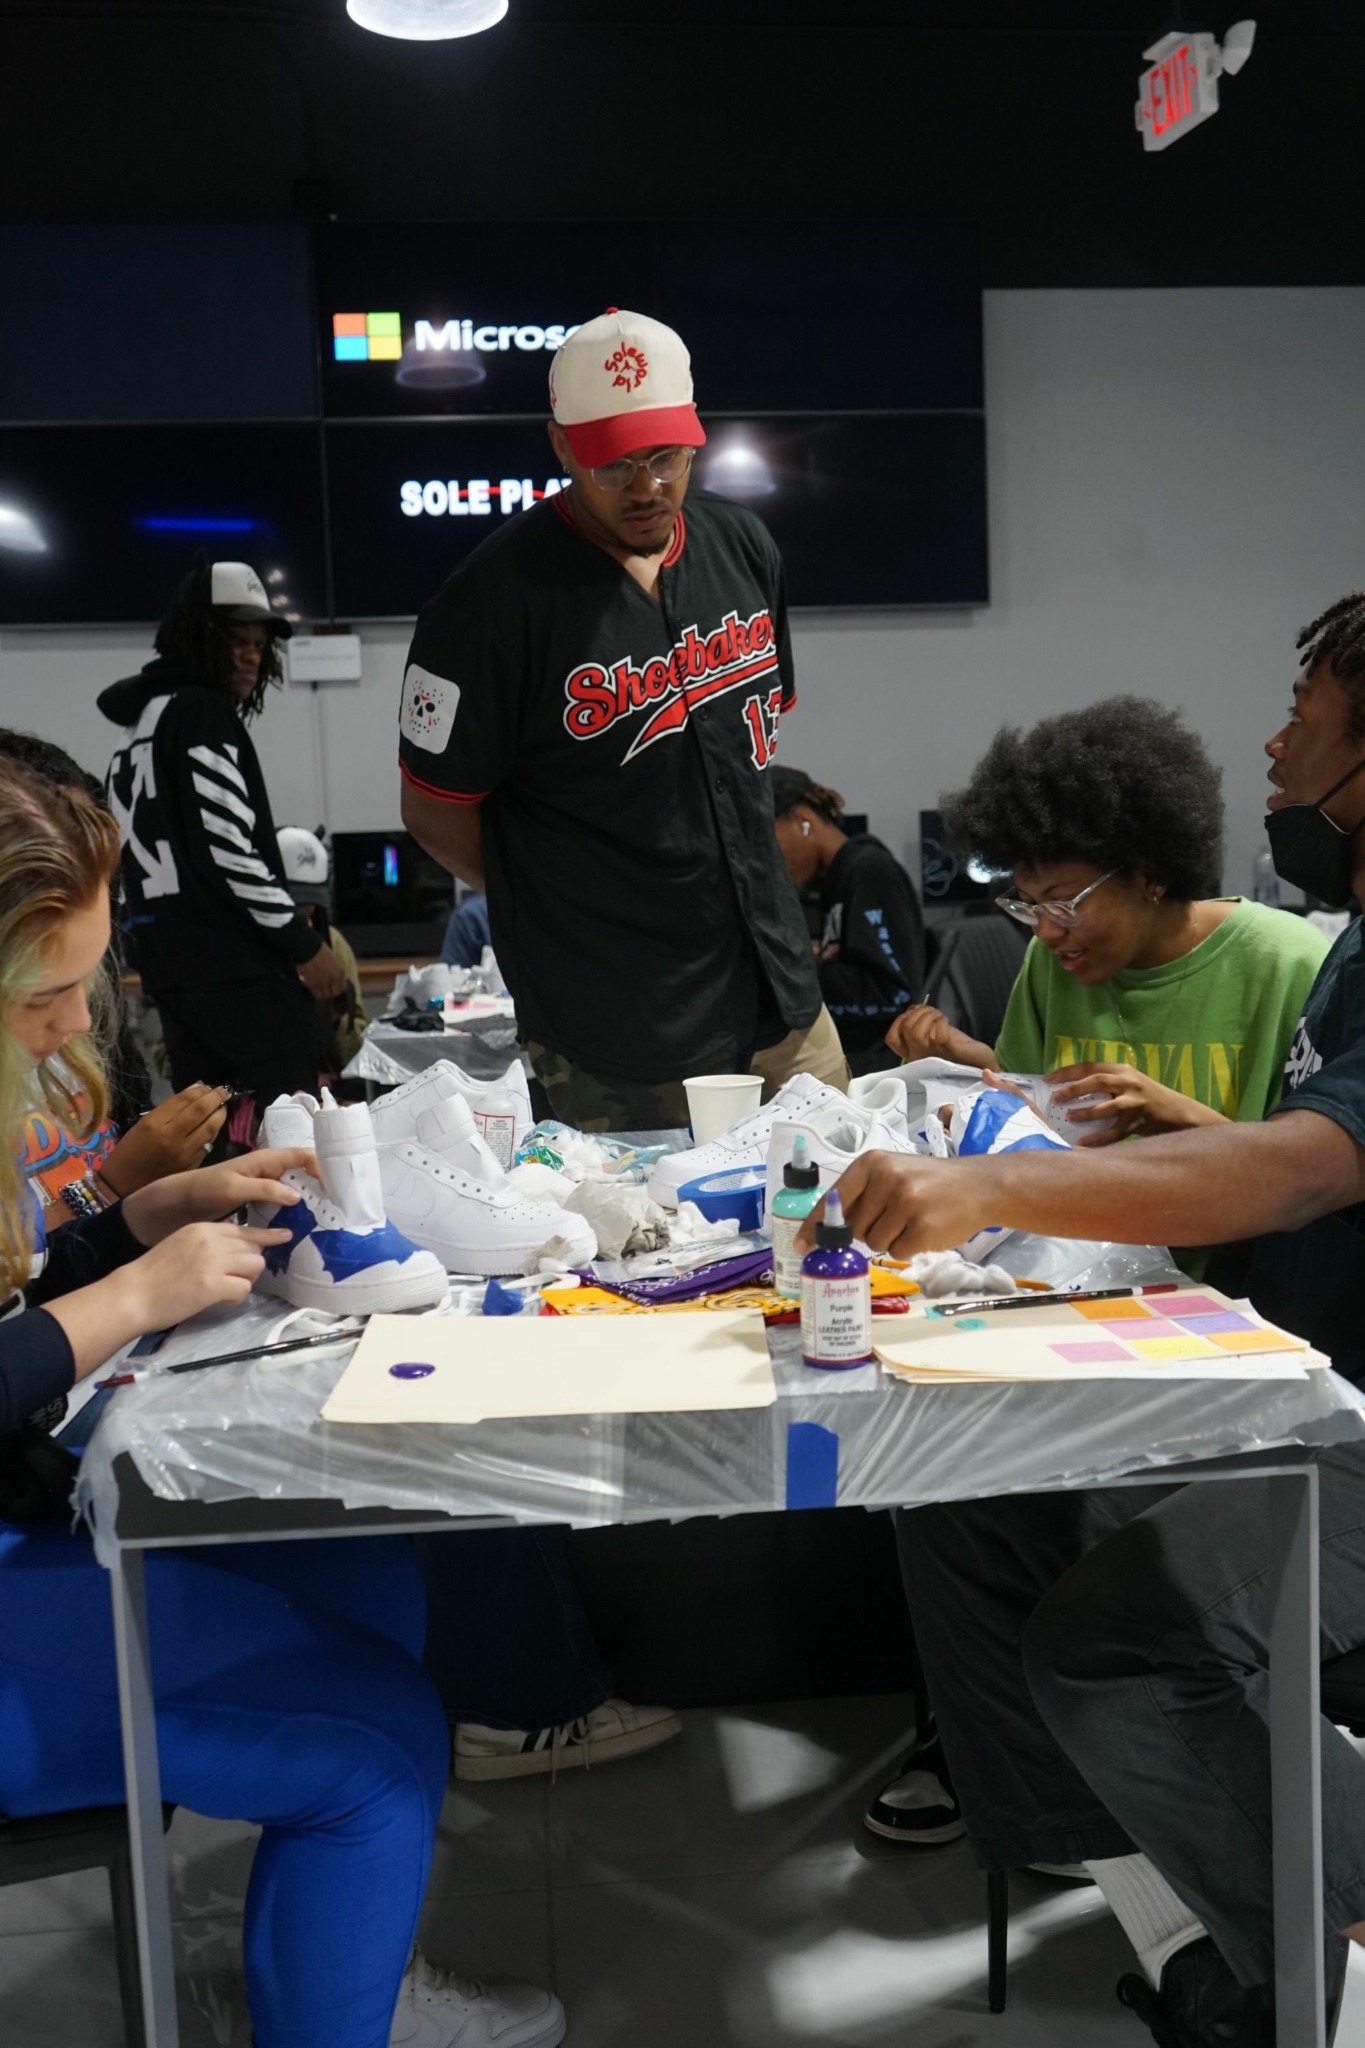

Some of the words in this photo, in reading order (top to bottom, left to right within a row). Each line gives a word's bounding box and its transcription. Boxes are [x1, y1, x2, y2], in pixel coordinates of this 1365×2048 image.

[1150, 45, 1191, 137] EXIT
[400, 480, 491, 516] SOLE
[499, 477, 573, 515] PLA
[830, 1304, 853, 1313] Purple
[818, 1325, 846, 1334] LEATHER
